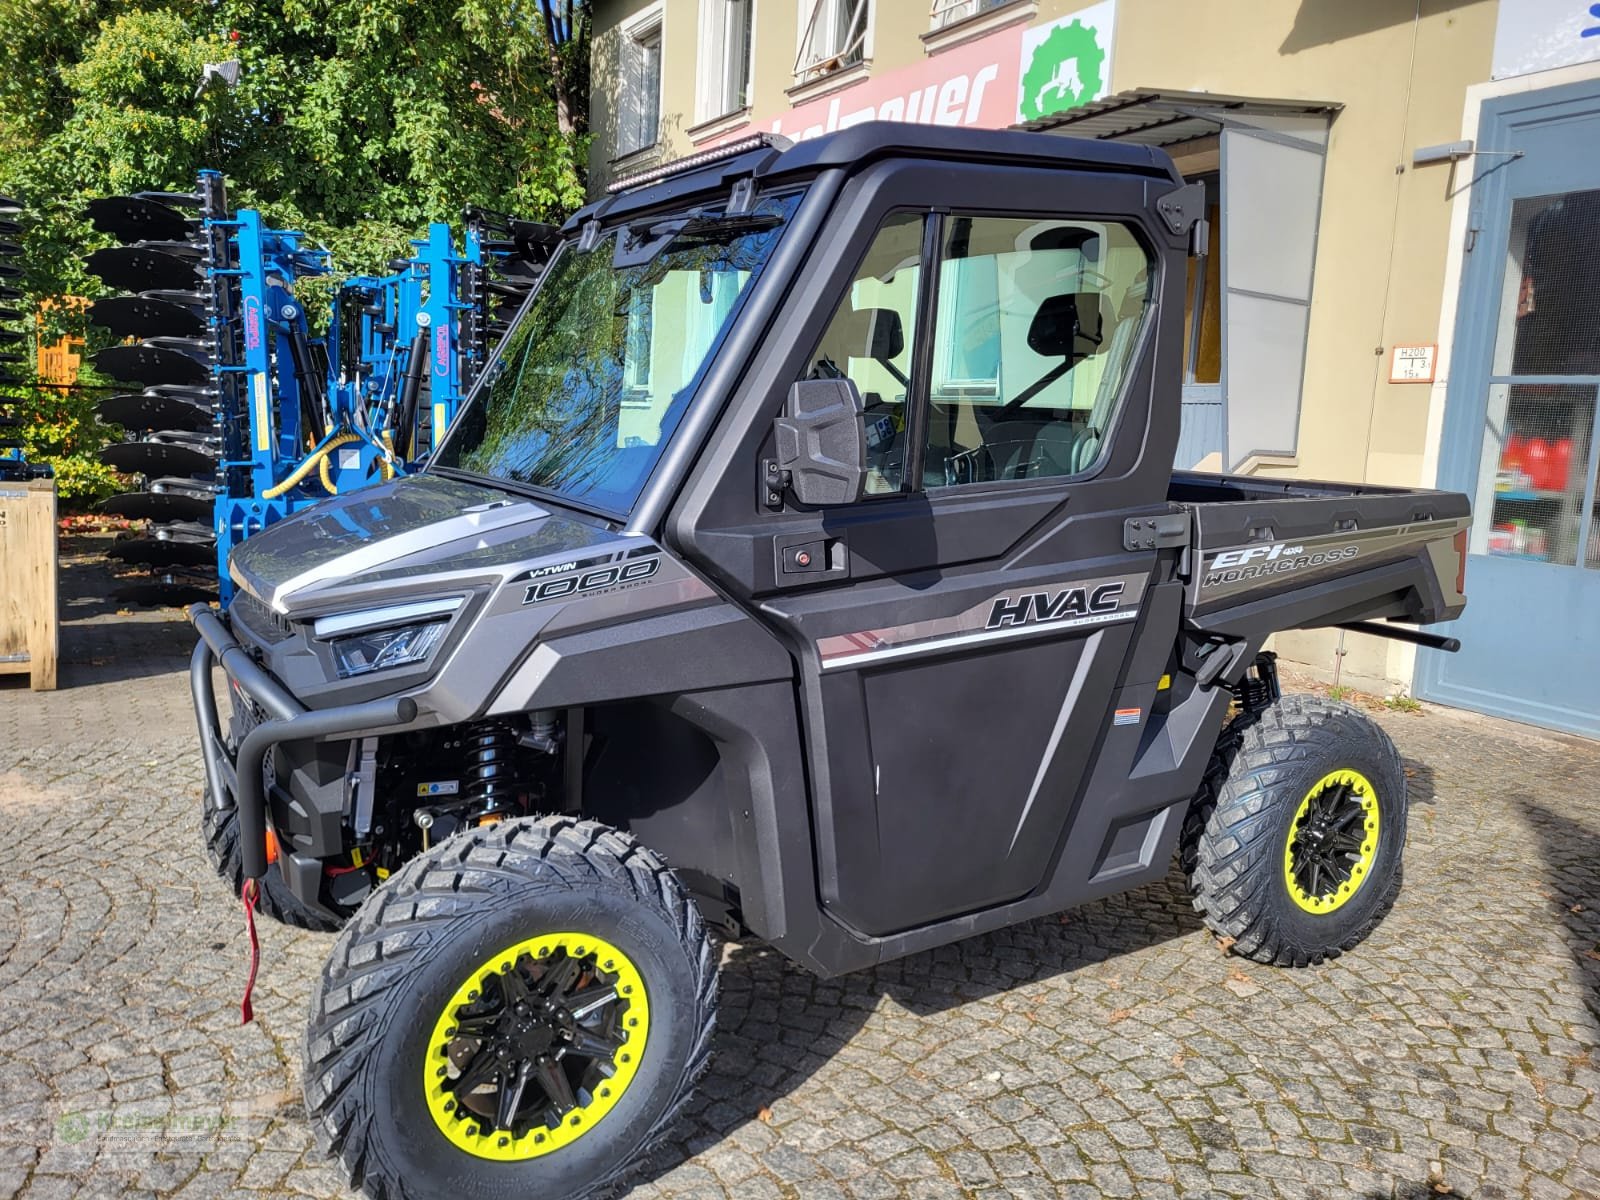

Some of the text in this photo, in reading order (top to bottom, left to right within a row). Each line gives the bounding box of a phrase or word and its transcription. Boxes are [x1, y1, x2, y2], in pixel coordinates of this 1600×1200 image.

[1401, 347, 1426, 357] H200
[529, 562, 577, 578] V-TWIN
[1202, 546, 1360, 587] WORKCROSS
[1210, 544, 1285, 570] EFI
[521, 557, 661, 606] 1000
[985, 582, 1125, 630] HVAC
